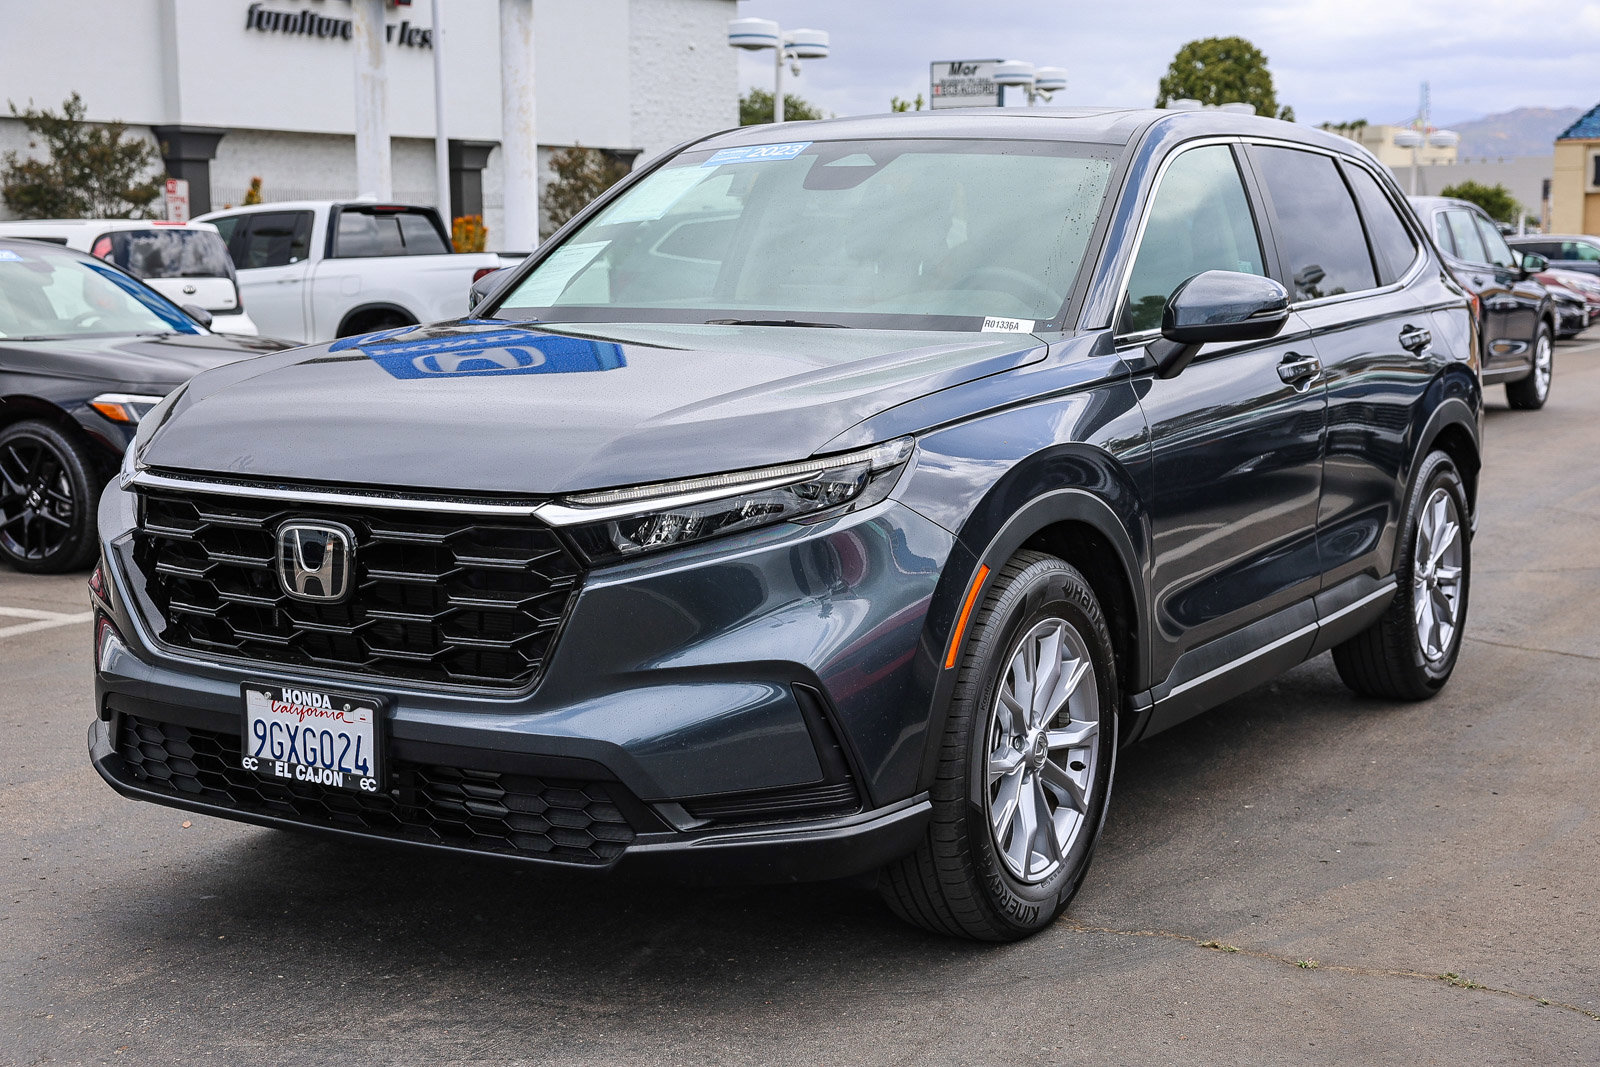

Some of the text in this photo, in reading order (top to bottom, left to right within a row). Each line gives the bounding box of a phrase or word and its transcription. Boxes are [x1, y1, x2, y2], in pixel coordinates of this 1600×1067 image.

[747, 145, 804, 158] 2023
[281, 688, 332, 709] HONDA
[271, 700, 354, 723] California
[253, 719, 369, 776] 9GXG024
[275, 761, 343, 787] EL CAJON
